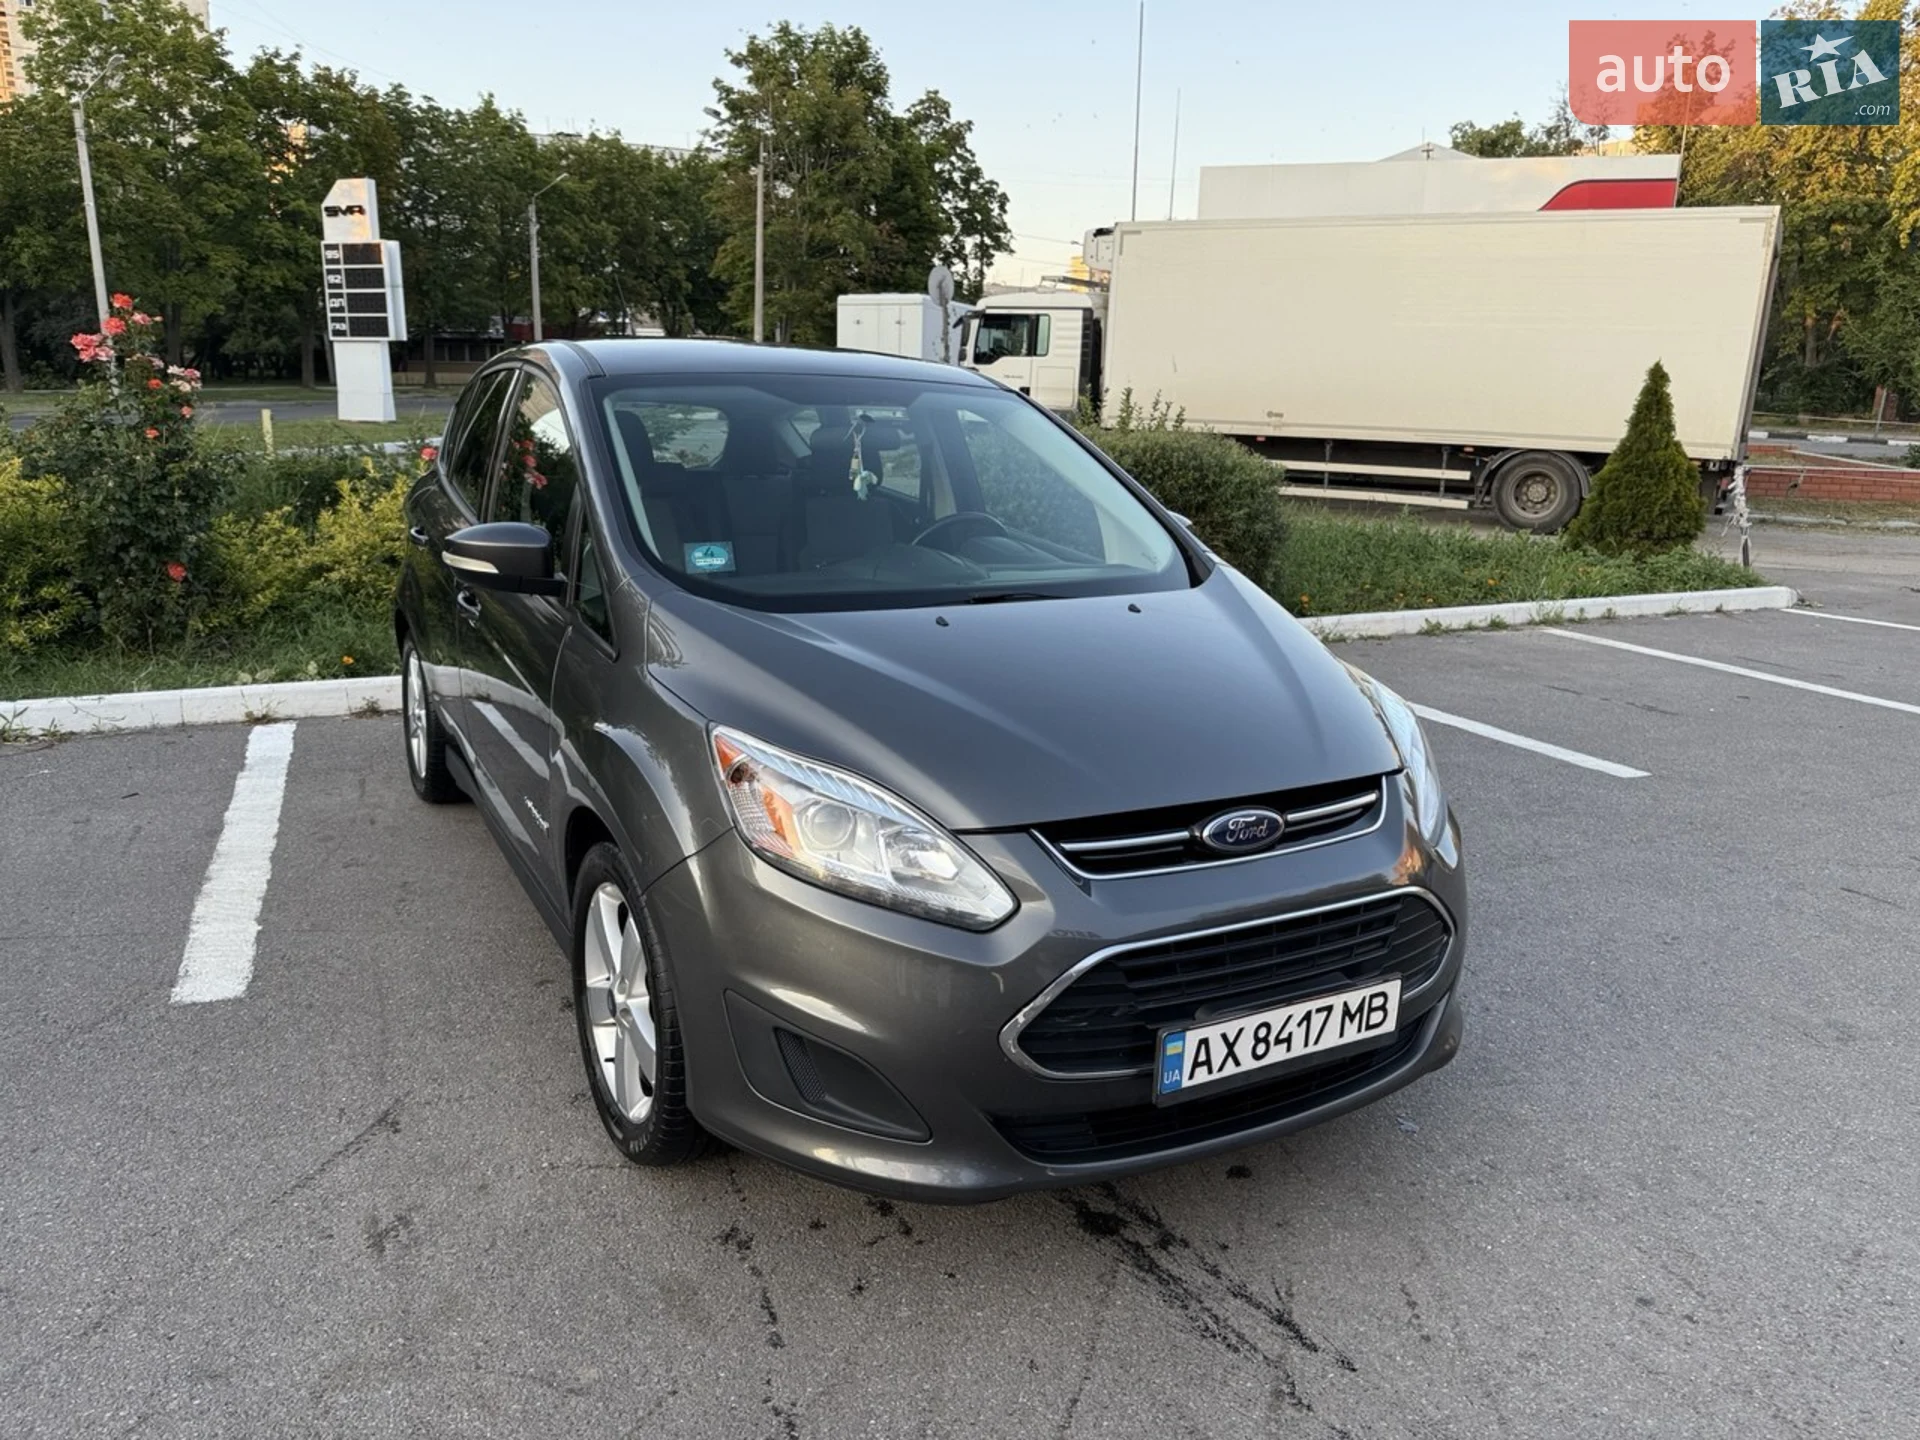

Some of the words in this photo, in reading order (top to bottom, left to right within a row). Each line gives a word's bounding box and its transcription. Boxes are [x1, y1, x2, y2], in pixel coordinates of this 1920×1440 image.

[325, 250, 339, 259] 95
[327, 274, 342, 284] 92
[1226, 815, 1269, 843] Ford
[1188, 1027, 1244, 1080] AX
[1251, 1004, 1334, 1062] 8417
[1338, 991, 1389, 1039] MB
[1163, 1069, 1181, 1084] UA
